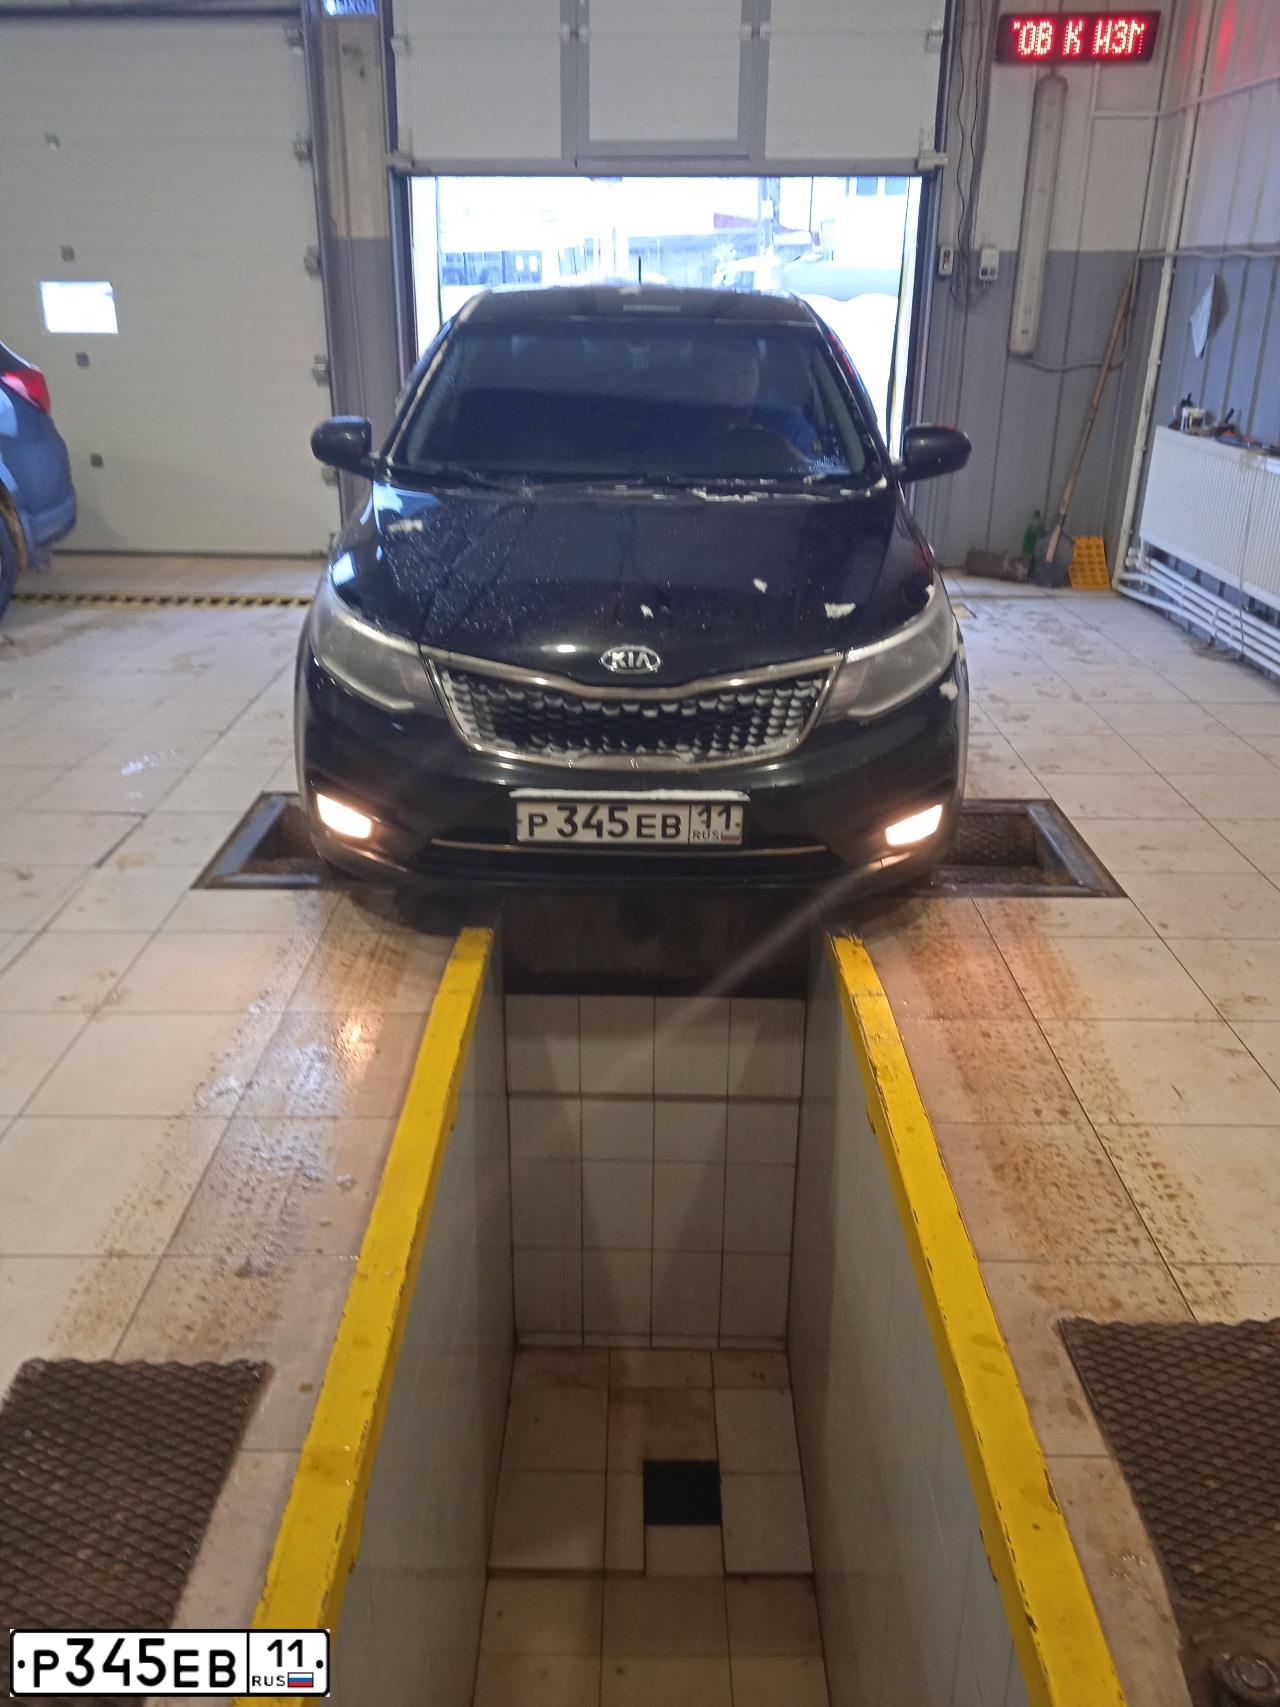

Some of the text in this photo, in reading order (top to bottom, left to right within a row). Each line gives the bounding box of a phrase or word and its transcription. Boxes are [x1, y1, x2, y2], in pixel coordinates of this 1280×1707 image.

[527, 803, 732, 838] Р345ЕВ 11
[692, 830, 719, 841] RUS
